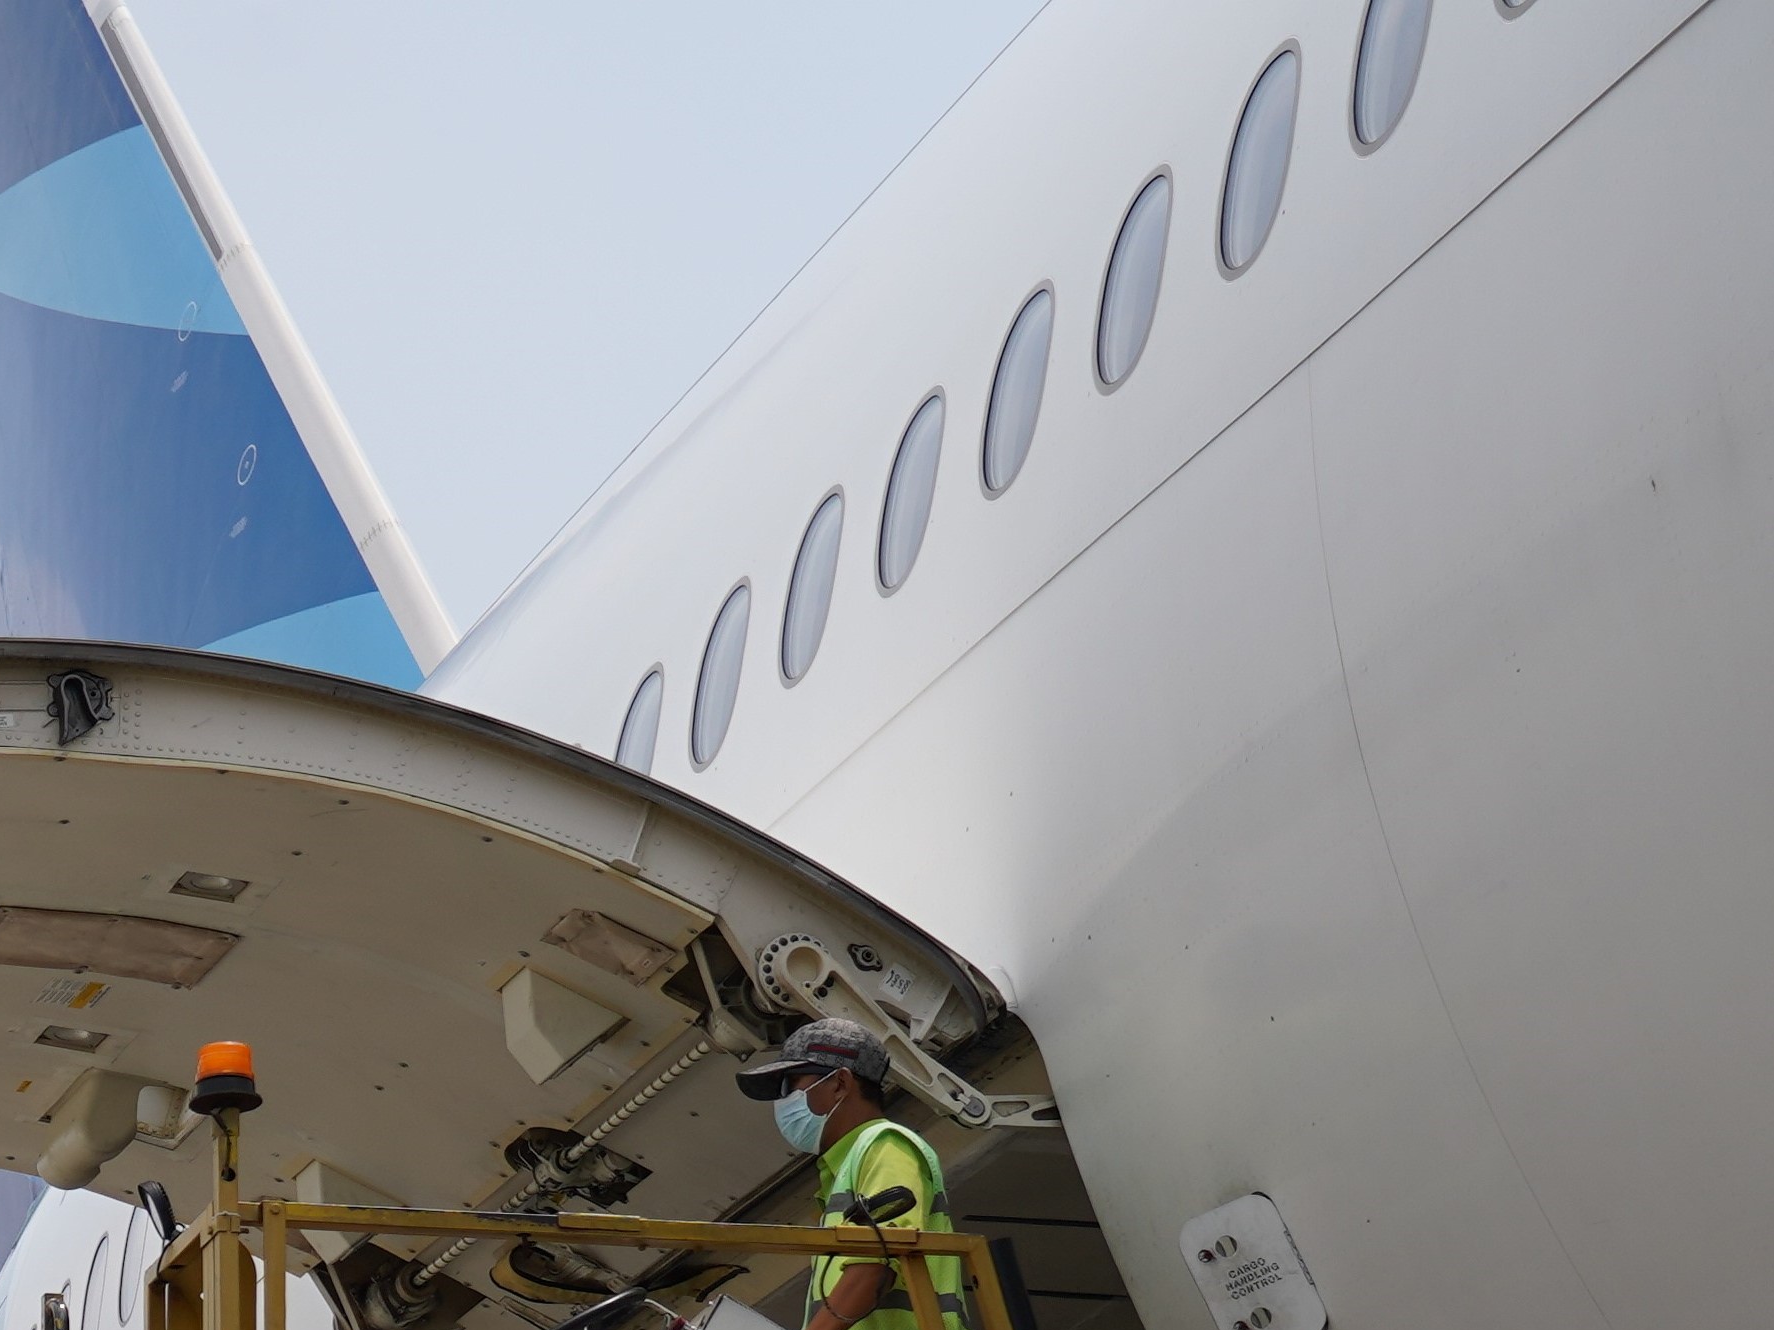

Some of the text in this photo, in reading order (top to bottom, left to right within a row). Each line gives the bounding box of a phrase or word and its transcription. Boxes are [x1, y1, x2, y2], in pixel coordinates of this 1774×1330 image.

[1225, 1262, 1280, 1291] HANDLING
[1228, 1257, 1266, 1279] CARGO
[1231, 1273, 1282, 1300] CONTROL
